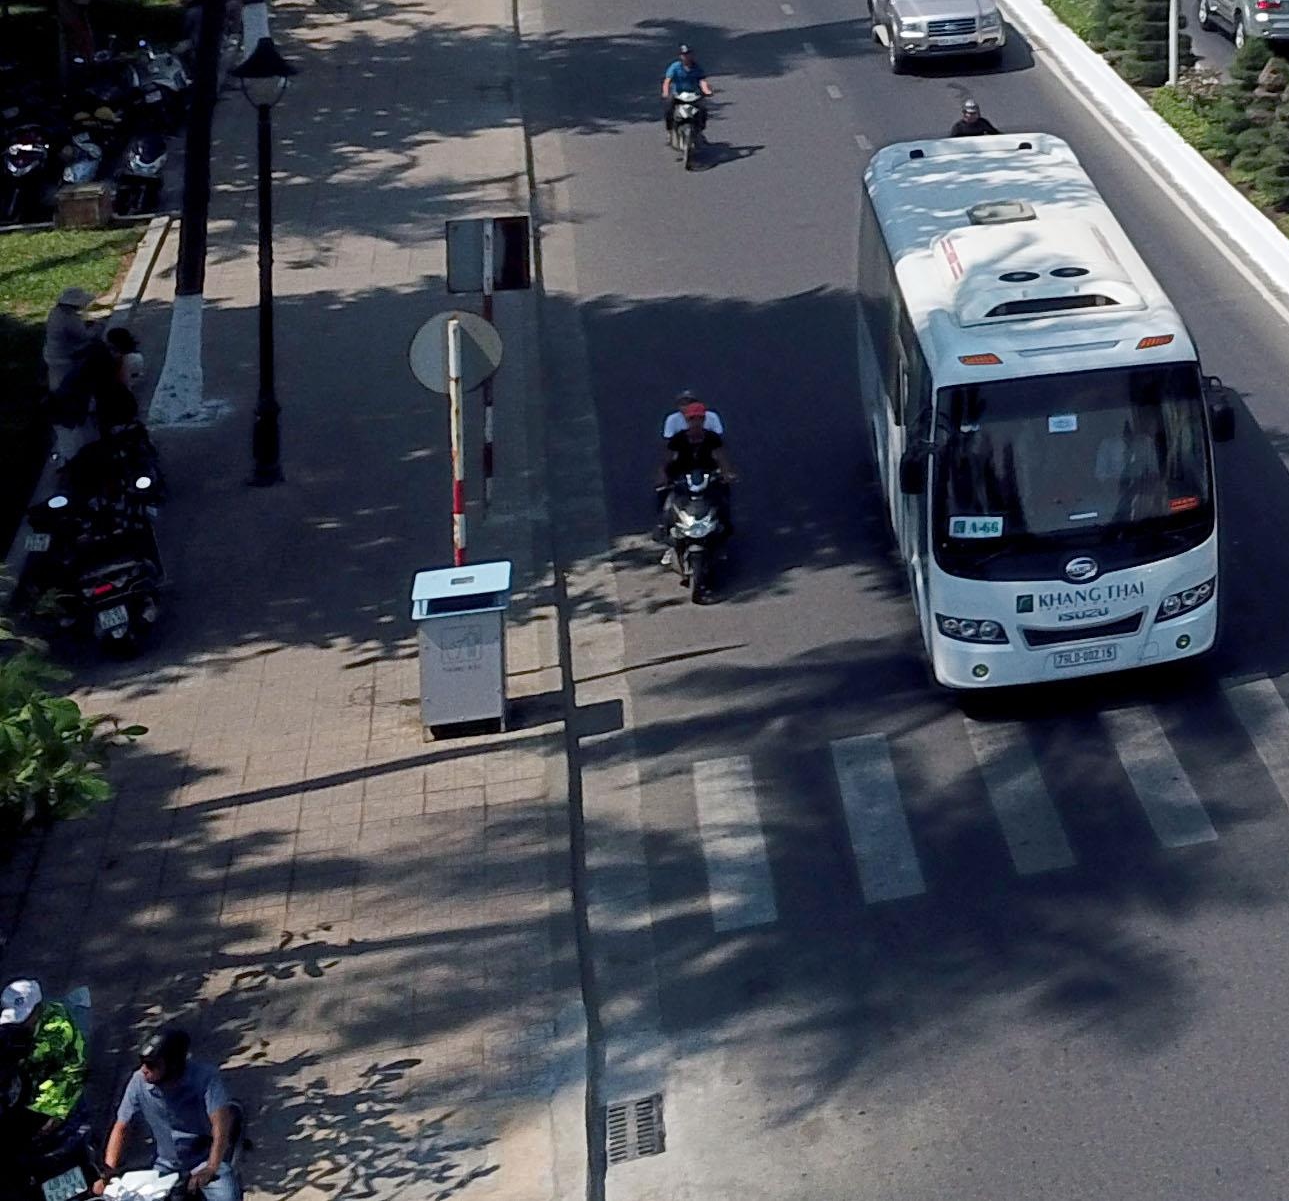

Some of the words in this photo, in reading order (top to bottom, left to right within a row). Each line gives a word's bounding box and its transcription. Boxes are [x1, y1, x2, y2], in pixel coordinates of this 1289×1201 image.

[1039, 587, 1101, 608] KHANG
[1104, 581, 1144, 599] THAI
[1058, 607, 1109, 621] ISUZU
